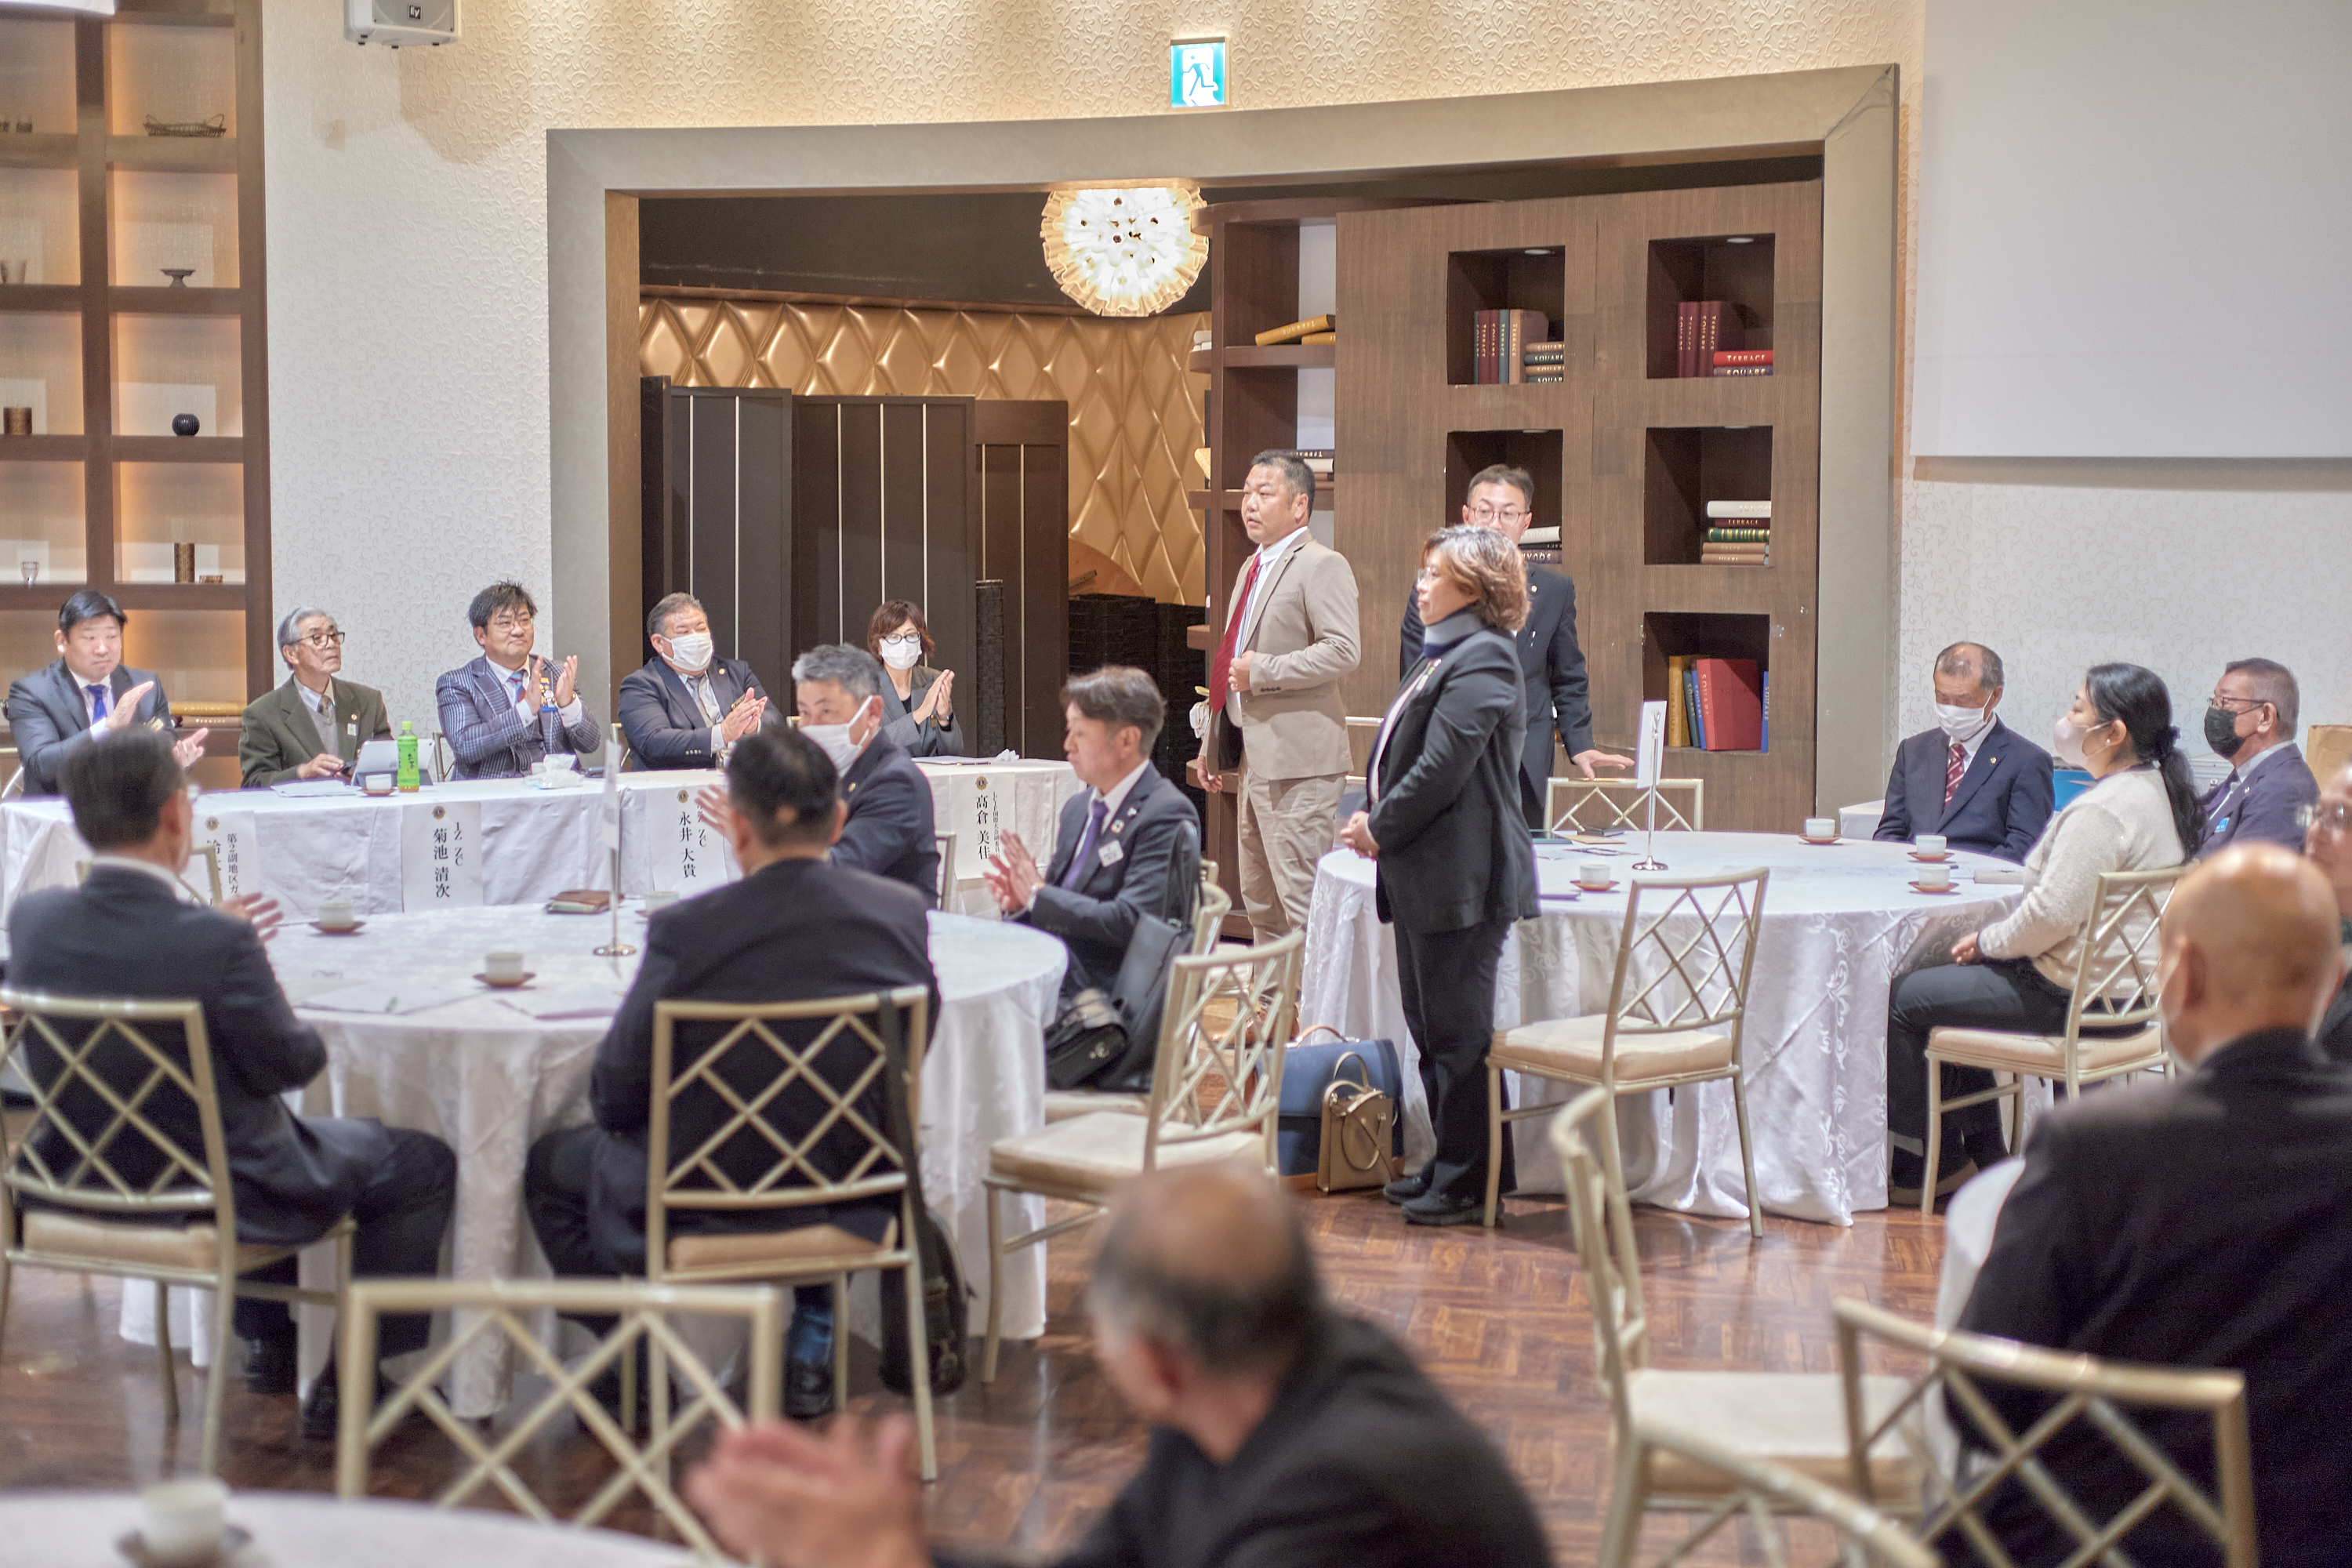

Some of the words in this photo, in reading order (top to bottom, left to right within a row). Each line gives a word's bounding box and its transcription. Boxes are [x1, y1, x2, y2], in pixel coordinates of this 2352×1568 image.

[1726, 368, 1766, 376] SQUARE
[454, 822, 463, 840] 1Z
[679, 811, 692, 843] 永井
[699, 829, 706, 848] ZC
[433, 828, 448, 860] 菊池
[455, 847, 463, 866] ZC
[681, 848, 696, 880] 大貴
[434, 866, 451, 899] 清次
